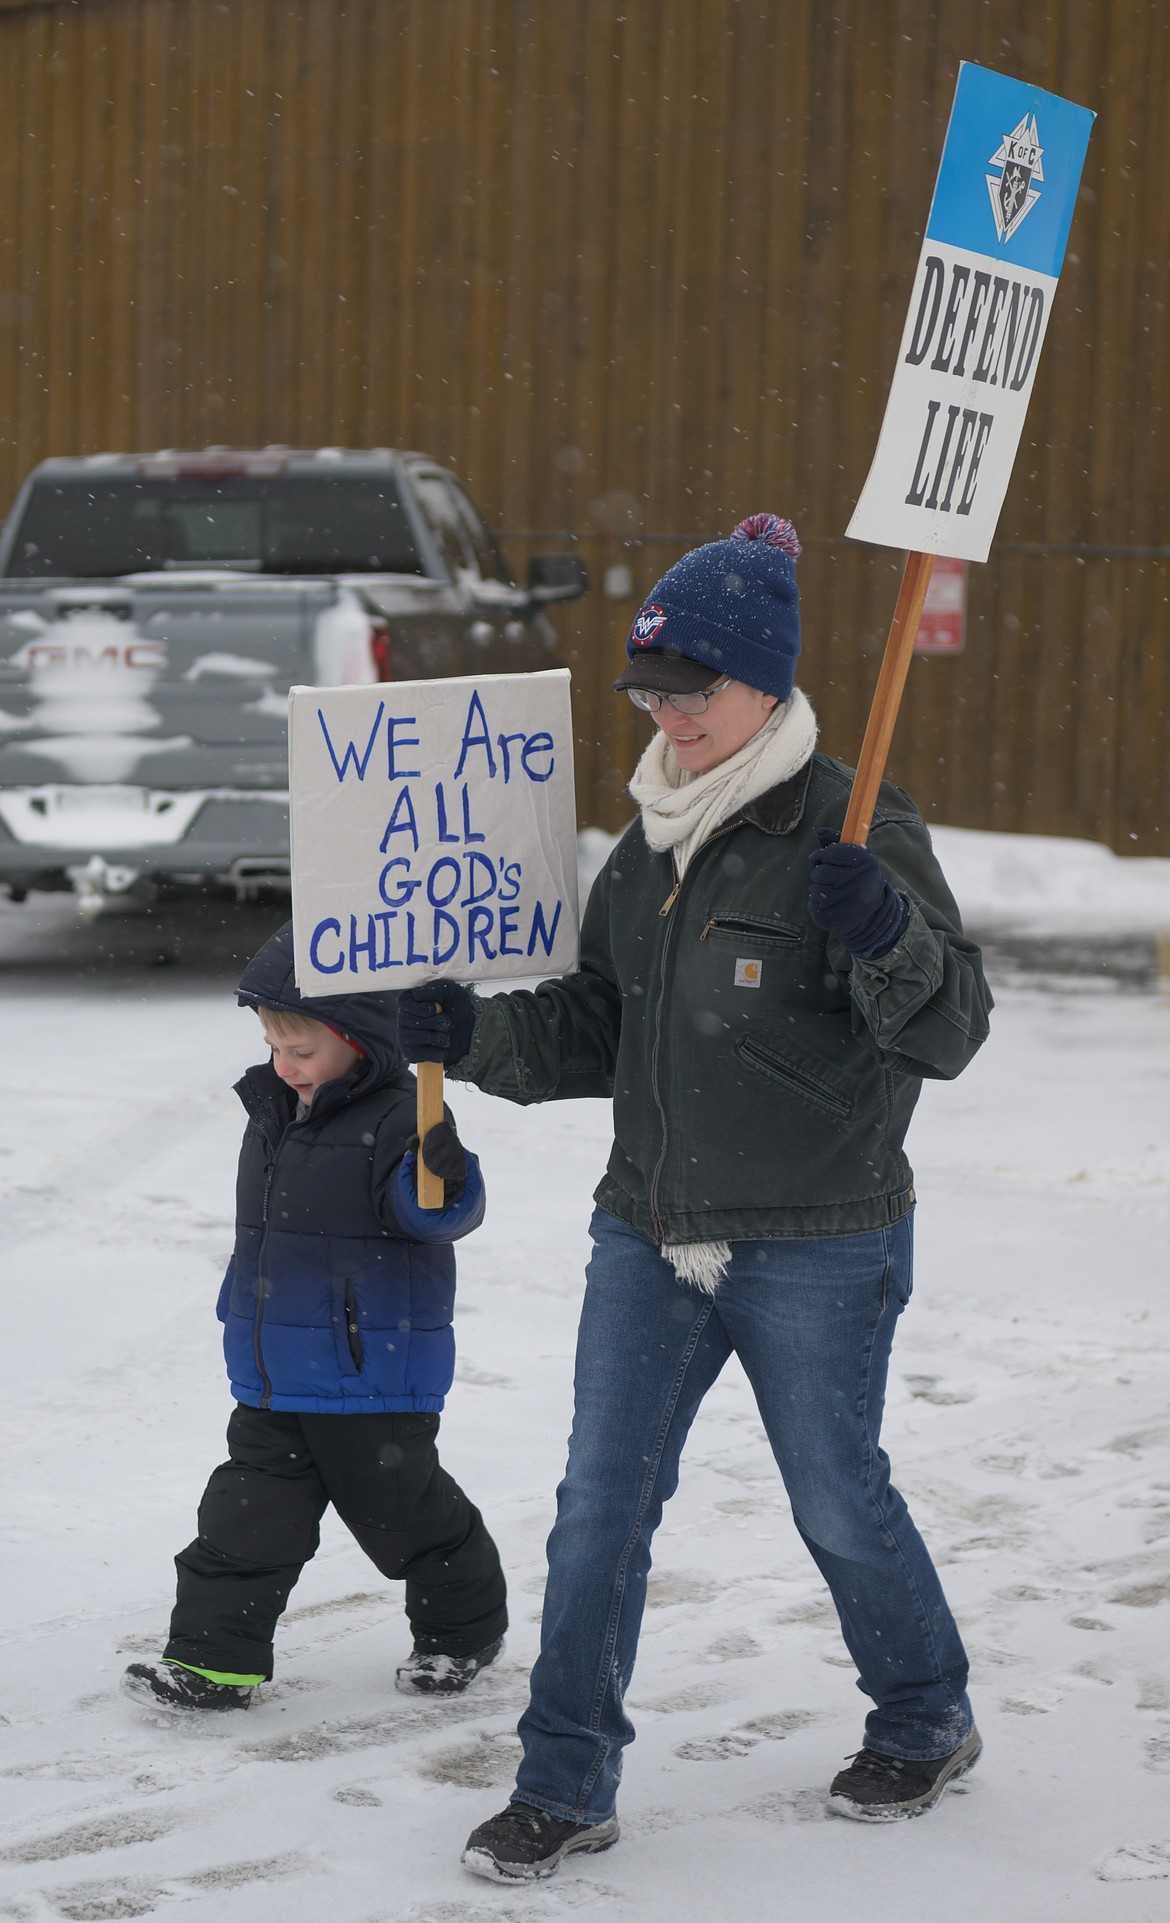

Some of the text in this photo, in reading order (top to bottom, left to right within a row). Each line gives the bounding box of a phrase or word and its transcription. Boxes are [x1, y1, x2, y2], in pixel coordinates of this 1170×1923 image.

[1008, 140, 1018, 159] K
[1028, 148, 1036, 165] C
[905, 256, 1044, 391] DEFEND
[905, 400, 994, 515] LIFE
[28, 645, 167, 668] GMC
[318, 689, 554, 783] WE Are
[379, 782, 486, 853] ALL
[379, 851, 522, 907] GOD's
[309, 900, 562, 974] CHILDREN
